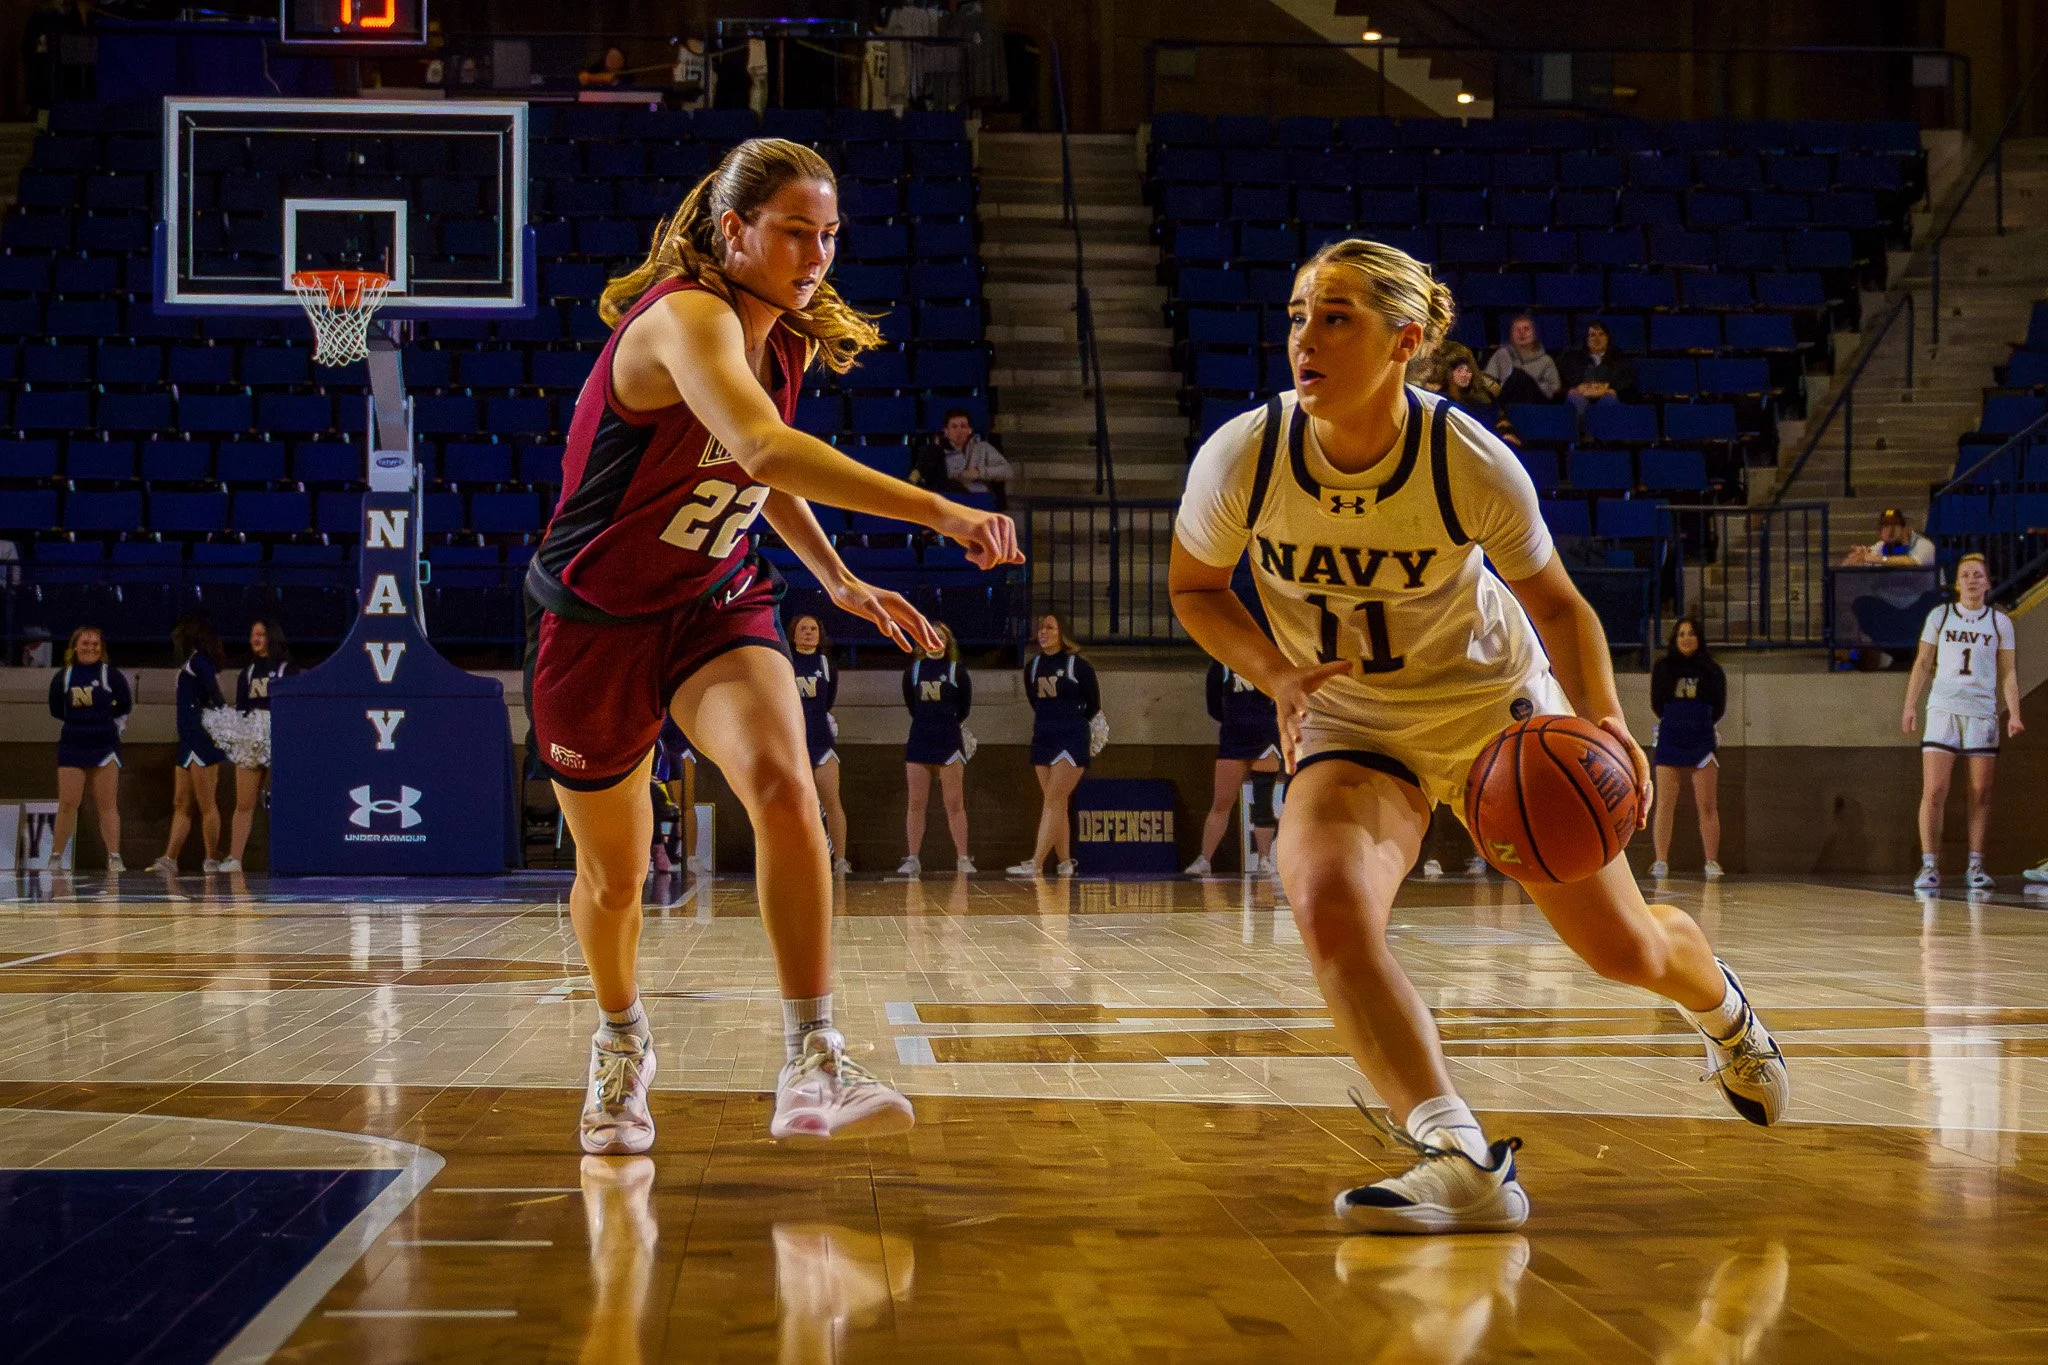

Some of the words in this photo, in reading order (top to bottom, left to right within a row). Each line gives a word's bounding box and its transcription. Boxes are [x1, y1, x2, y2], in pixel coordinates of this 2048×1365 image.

[658, 479, 771, 559] 22
[1256, 534, 1437, 589] NAVY
[364, 510, 409, 751] NAVY
[1303, 594, 1405, 674] 11
[1945, 630, 1992, 646] NAVY
[1959, 649, 1972, 676] 1
[71, 686, 93, 707] N
[250, 677, 268, 698] N
[796, 676, 817, 698] N
[921, 681, 942, 701] N
[1037, 675, 1057, 698] N
[1078, 810, 1174, 842] DEFENSE!
[344, 834, 380, 842] UNDER
[381, 834, 427, 842] ARMOUR
